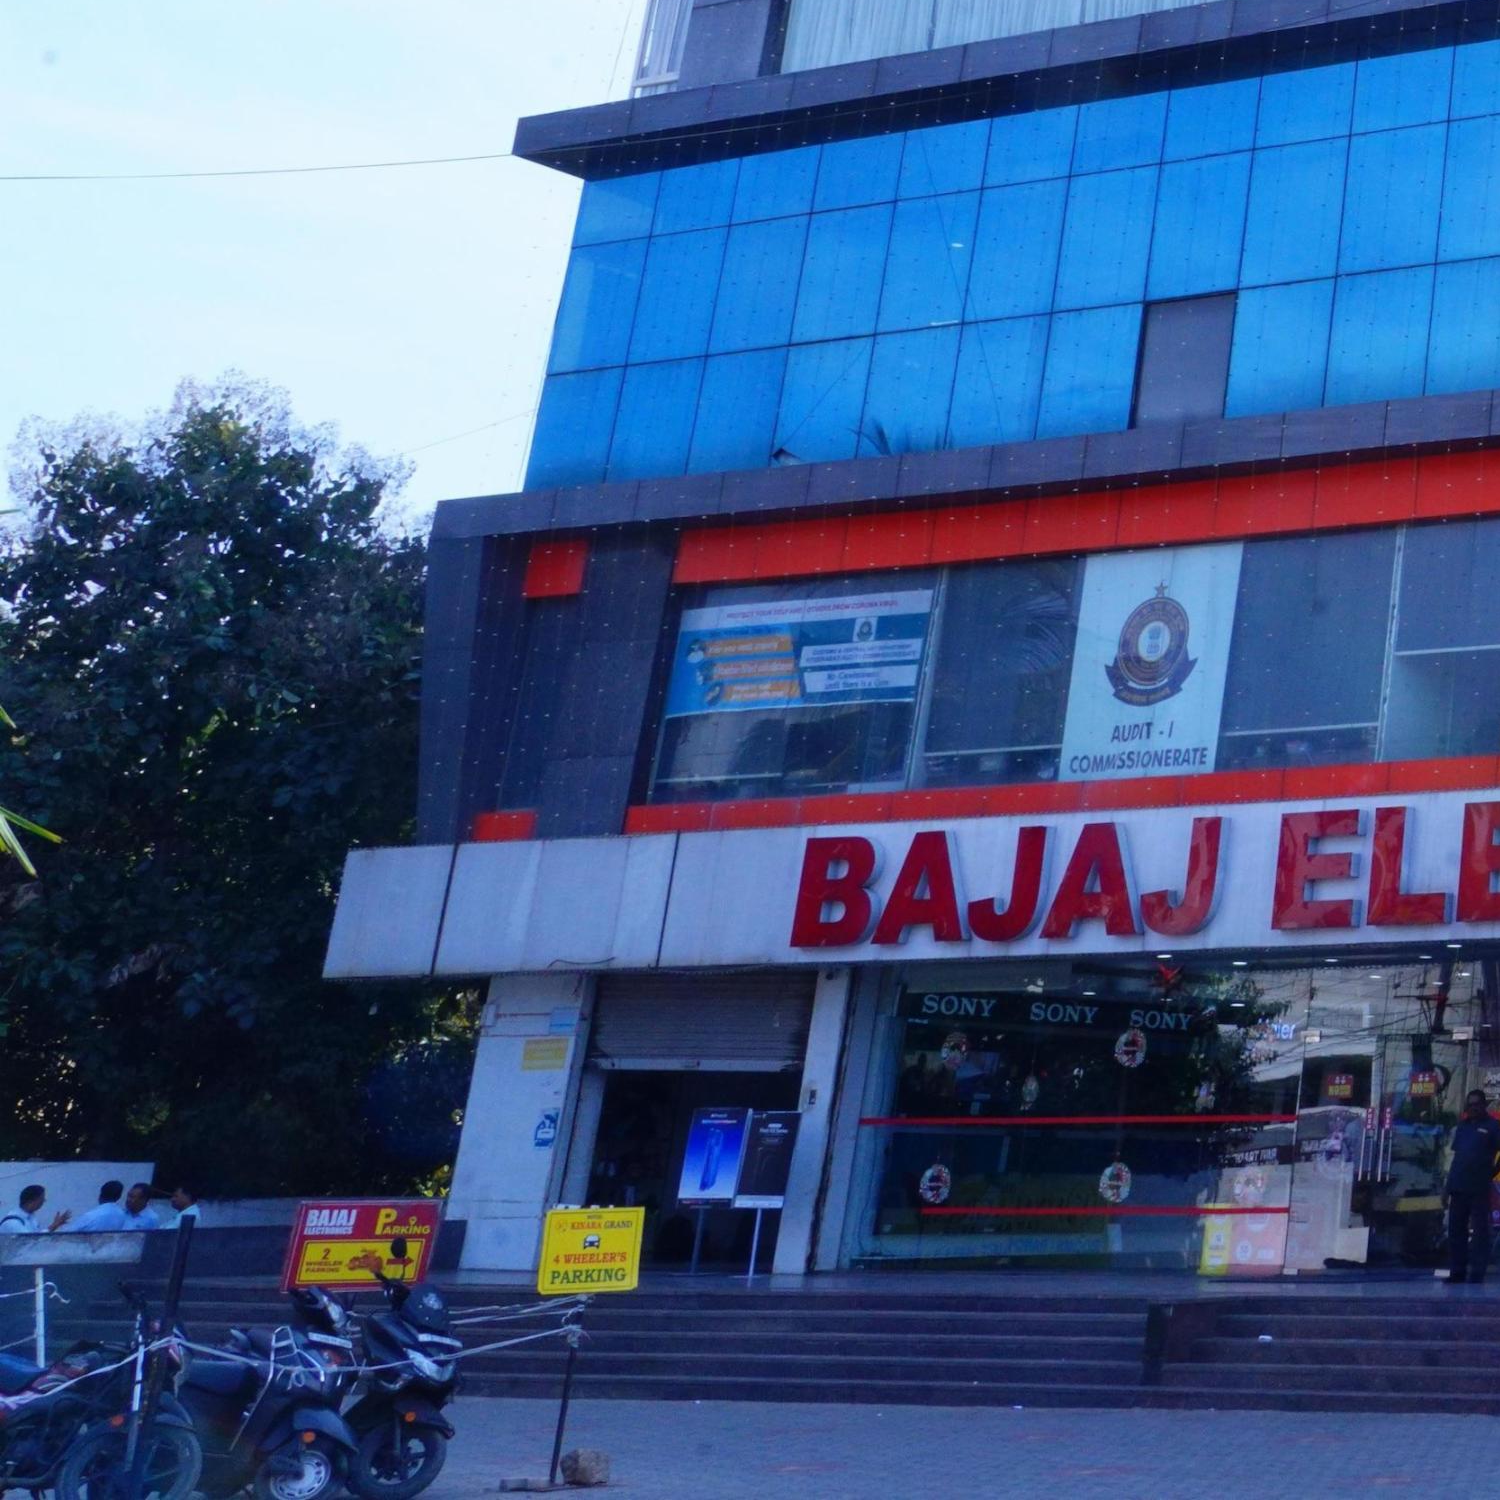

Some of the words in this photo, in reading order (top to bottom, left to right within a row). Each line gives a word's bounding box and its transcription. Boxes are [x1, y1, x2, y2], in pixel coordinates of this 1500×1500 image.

[1111, 722, 1153, 743] AUDIT
[1069, 747, 1208, 773] COMMISSIONERATE
[788, 815, 1228, 949] BAJAJ
[921, 994, 997, 1018] SONY
[1029, 1001, 1099, 1024] SONY
[1129, 1008, 1192, 1031] SONY
[303, 1226, 355, 1236] ELECTRONICS
[306, 1208, 358, 1227] BAJAJ
[374, 1207, 431, 1236] PARKING
[570, 1220, 602, 1230] KINARA
[604, 1219, 633, 1229] GRAND
[323, 1248, 331, 1260] 2
[553, 1254, 561, 1265] 4
[564, 1251, 628, 1264] WHEELER'S
[305, 1266, 341, 1274] PARKING
[550, 1267, 627, 1285] PARKING
